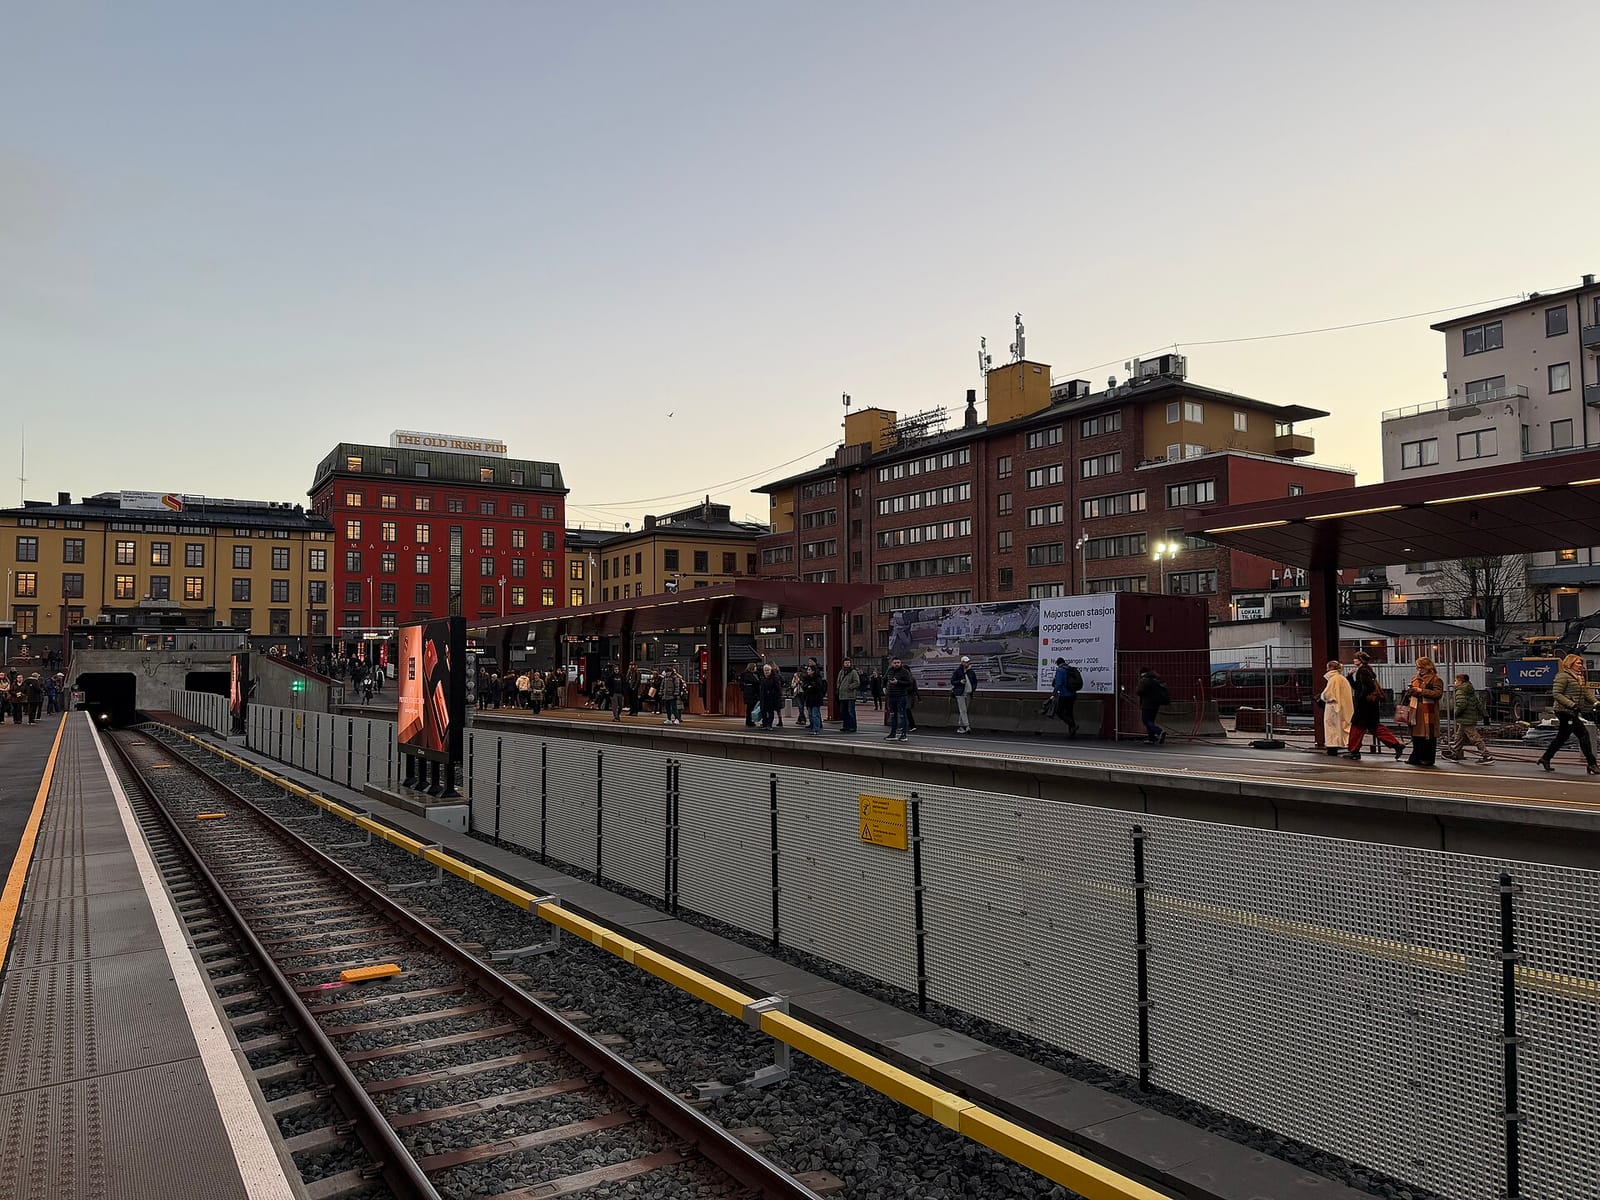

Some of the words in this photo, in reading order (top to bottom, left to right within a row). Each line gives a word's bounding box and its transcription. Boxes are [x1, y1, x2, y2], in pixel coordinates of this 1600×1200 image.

[397, 434, 420, 445] THE
[423, 437, 447, 447] OLD
[450, 440, 482, 451] IRISH
[485, 442, 507, 453] PUB
[1043, 609, 1085, 619] Majorstuen
[1086, 606, 1115, 617] stasjon
[1043, 621, 1092, 632] oppgraderes!
[1520, 669, 1543, 677] NCC
